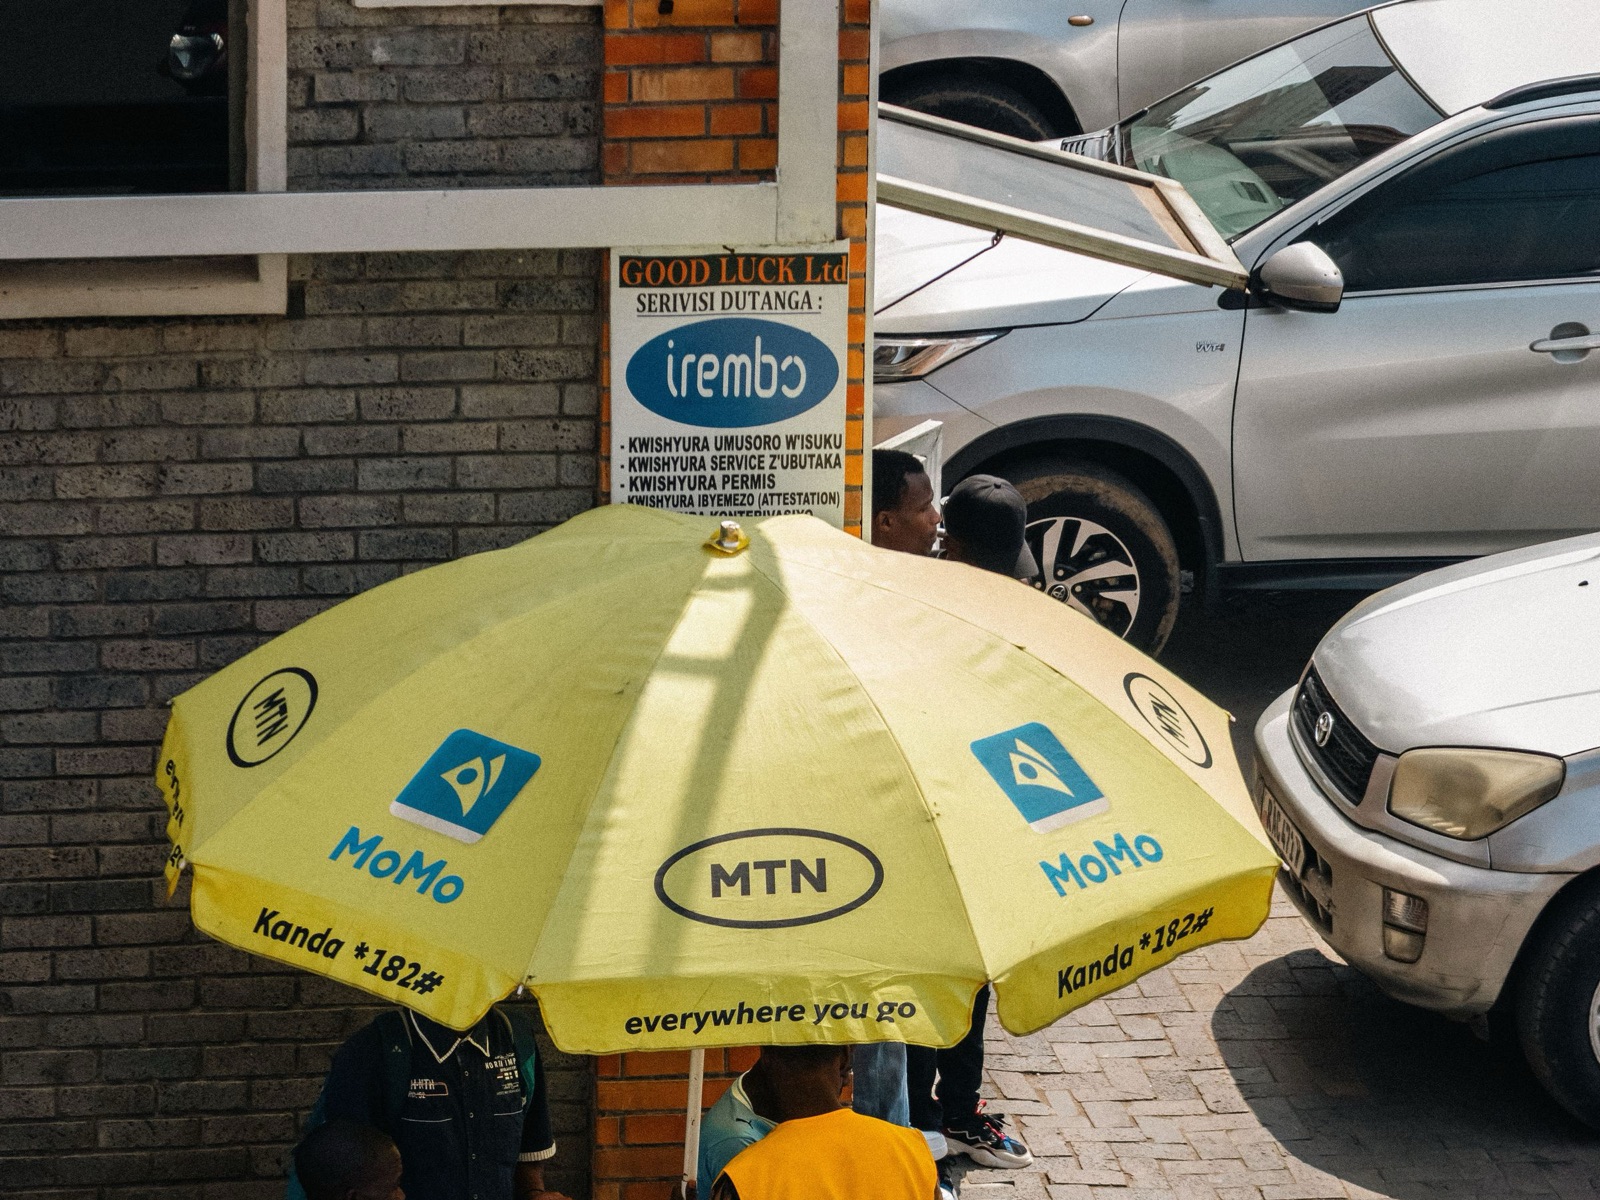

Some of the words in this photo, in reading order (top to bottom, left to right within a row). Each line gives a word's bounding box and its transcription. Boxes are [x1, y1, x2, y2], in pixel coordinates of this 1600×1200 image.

[622, 258, 710, 286] GOOD
[720, 256, 796, 284] LUCK
[804, 256, 848, 283] Ltd
[637, 292, 715, 313] SERIVISI
[720, 290, 813, 311] DUTANGA
[628, 436, 710, 453] KWISHYURA
[714, 434, 782, 452] UMUSORO
[785, 433, 843, 450] W'ISUKU
[628, 456, 707, 473] KWISHYURA
[711, 454, 765, 471] SERVICE
[769, 453, 842, 470] Z'UBUTAKA
[628, 475, 717, 492] KWISHYURA
[721, 473, 776, 490] PERMIS
[698, 492, 755, 507] IBYEMEZO
[757, 491, 841, 509] (ATTESTATION)
[253, 687, 288, 747] MTN
[328, 825, 465, 904] MoMo
[710, 857, 828, 898] MTN
[1039, 832, 1165, 898] MoMo
[253, 907, 346, 960] Kanda
[1057, 941, 1134, 998] Kanda
[624, 1000, 806, 1036] everywhere
[812, 1002, 868, 1026] you
[876, 1001, 917, 1024] go
